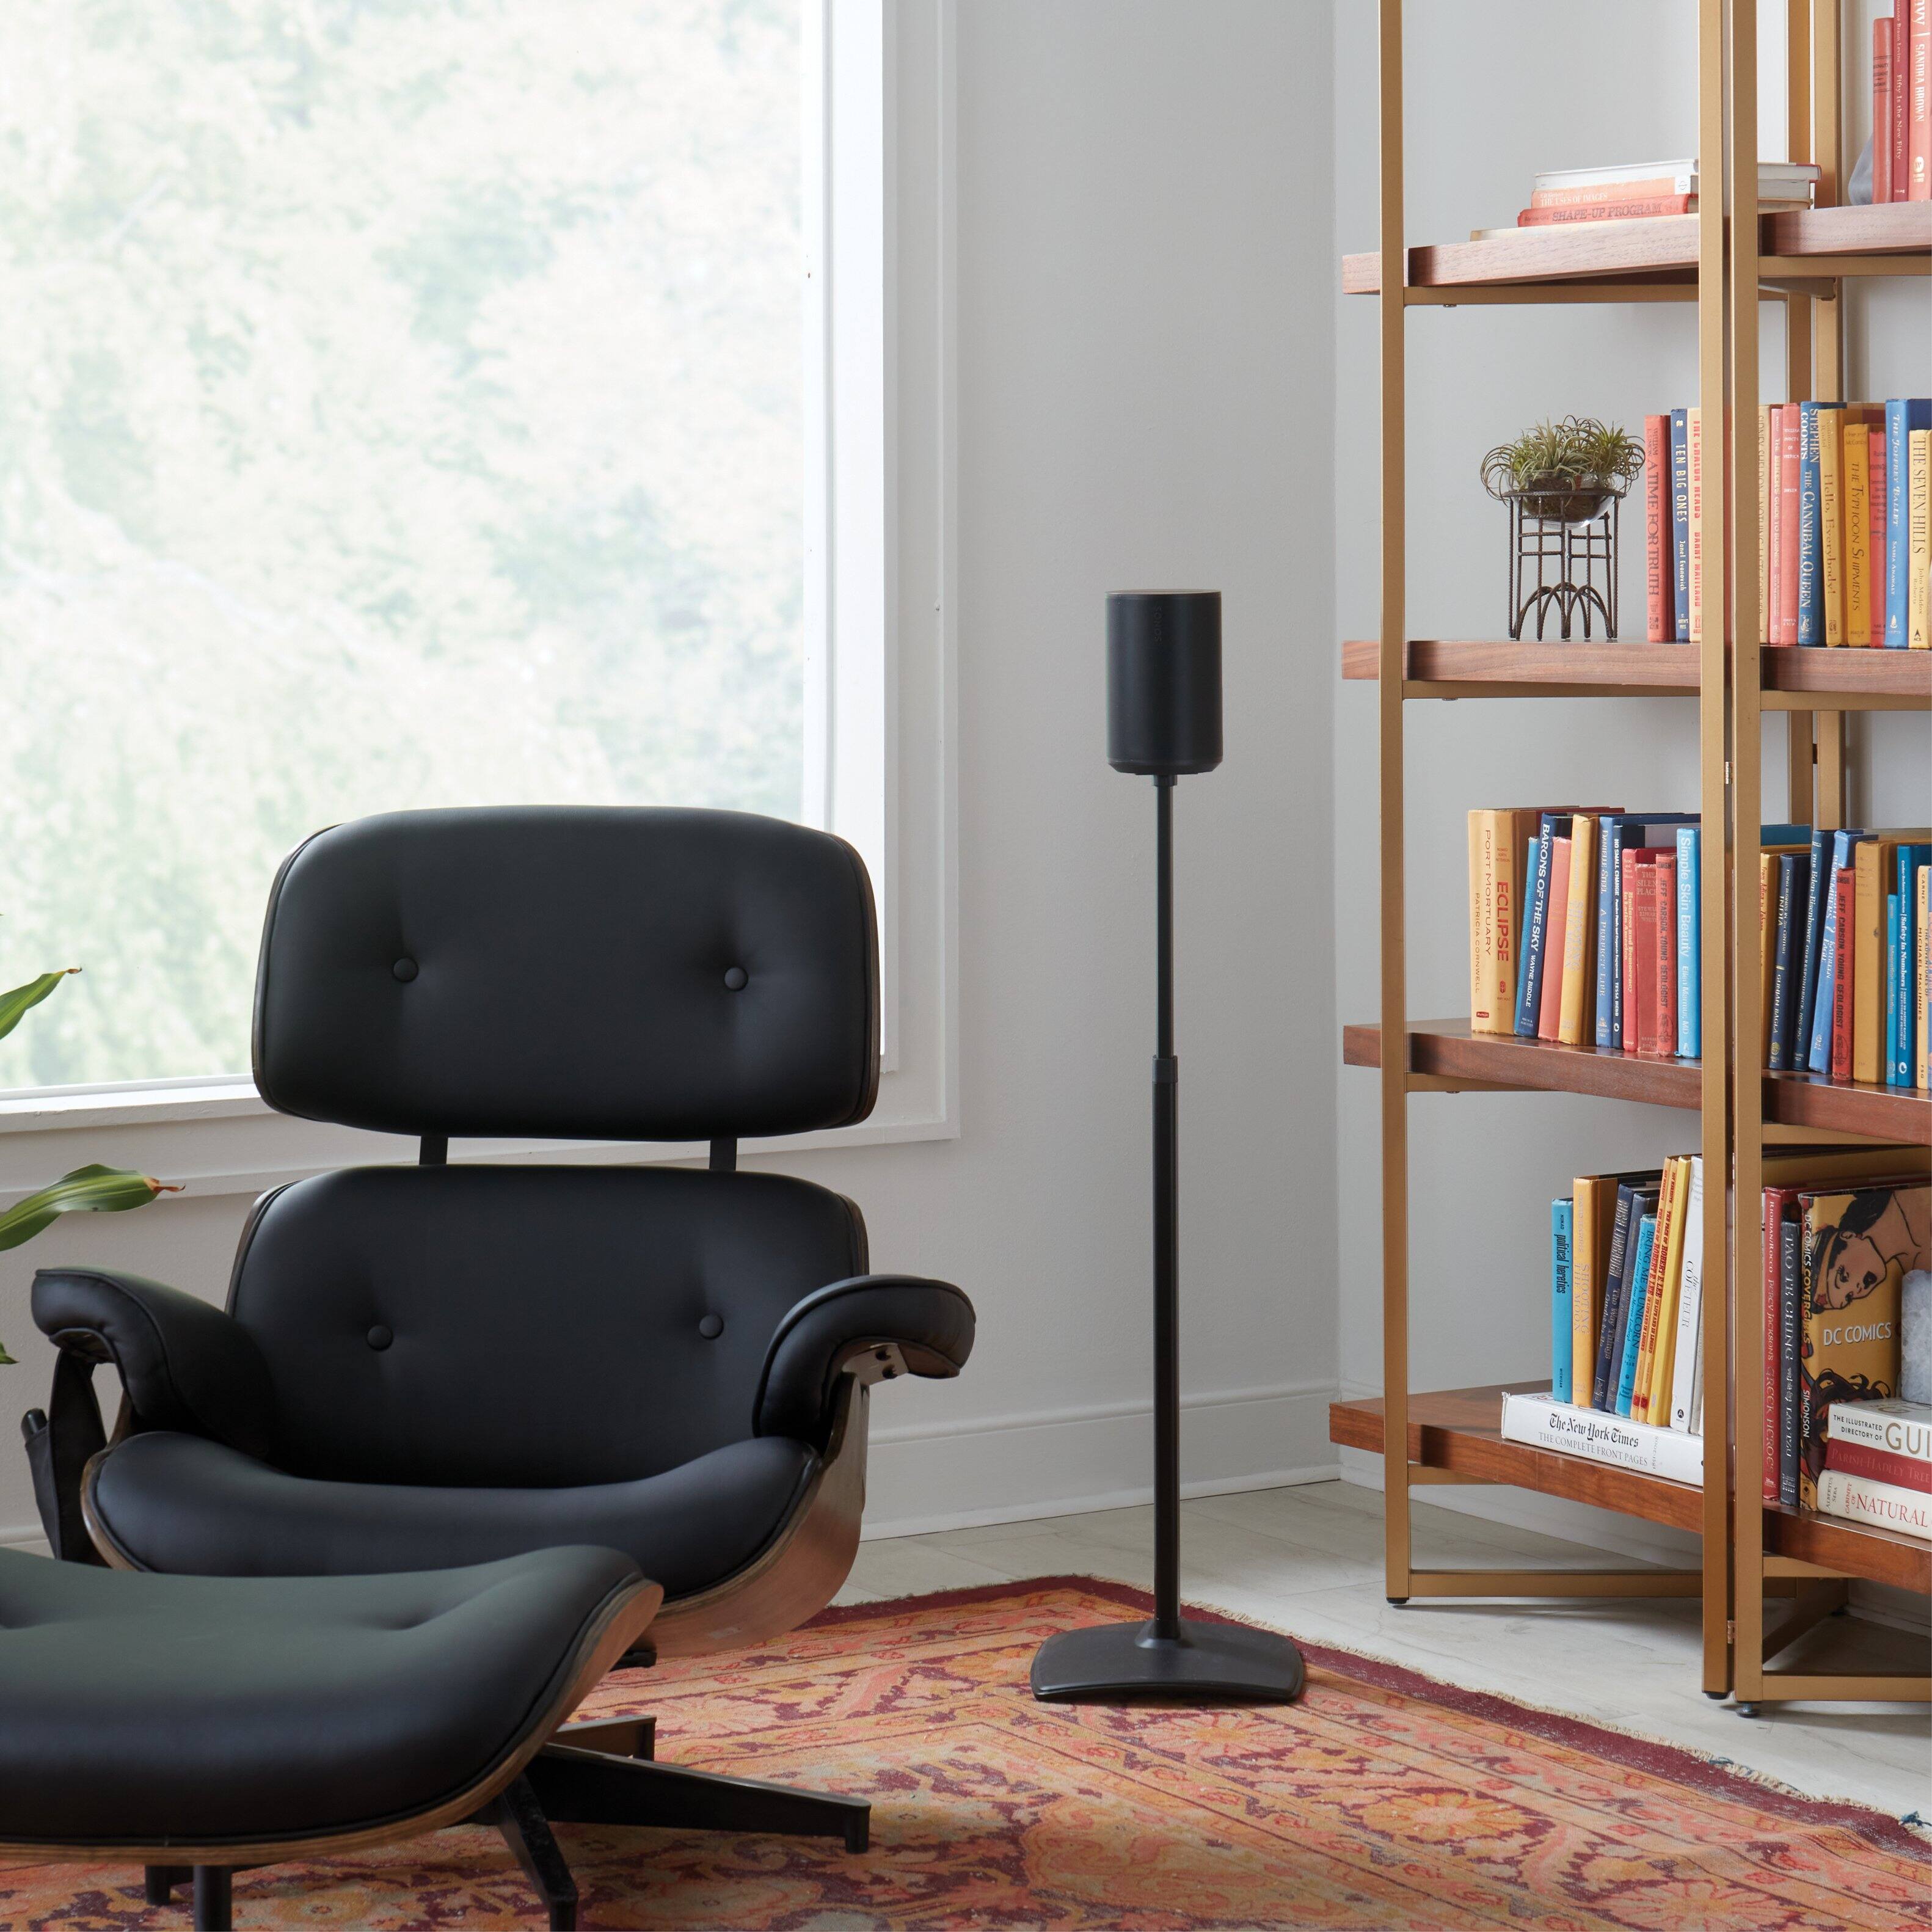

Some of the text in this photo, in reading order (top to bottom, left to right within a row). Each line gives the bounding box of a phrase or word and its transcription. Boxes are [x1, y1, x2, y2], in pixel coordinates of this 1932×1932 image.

[1915, 43, 1925, 122] SANDRA BROWN
[1540, 198, 1552, 206] THE
[1556, 197, 1572, 205] USES
[1583, 193, 1608, 202] IMAGES
[1552, 208, 1606, 222] SHAPE-UP
[1608, 203, 1662, 217] PROGRAM
[1809, 409, 1819, 462] STEPHEN
[1648, 459, 1658, 471] A
[1892, 439, 1900, 483] JOFFREY
[1648, 472, 1658, 510] TIME
[1675, 444, 1687, 522] TEN BIG ONES
[1912, 437, 1926, 553] THE SEVEN HILLS
[1648, 513, 1658, 545] FOR
[1774, 522, 1779, 531] TO
[1802, 491, 1815, 559] CANNIBAL
[1851, 485, 1864, 544] TYPHOON
[1824, 475, 1836, 594] Hello, Everybody!
[1649, 547, 1659, 596] TRUTH
[1801, 561, 1814, 607] QUEEN
[1852, 547, 1864, 611] SHIPMENTS
[1154, 605, 1162, 641] SONOS
[1614, 839, 1619, 848] NO
[1531, 824, 1550, 952] BARONS OF THE SKY
[1679, 837, 1691, 957] Simple Skin Beauty
[1497, 881, 1509, 961] ECLIPSE
[1806, 870, 1818, 944] Eden-Eisenhower
[1528, 955, 1536, 980] WAYNE
[1925, 988, 1928, 997] OF
[1683, 1021, 1689, 1035] MD
[1609, 1200, 1629, 1278] RUSH LIMBAUGH
[1804, 1214, 1812, 1229] DC
[1555, 1234, 1569, 1262] political
[1643, 1231, 1654, 1263] BRING
[1650, 1243, 1660, 1272] ROBERT
[1658, 1245, 1668, 1275] ROBERT
[1785, 1234, 1794, 1270] TAO
[1556, 1264, 1569, 1294] heretics
[1641, 1267, 1650, 1283] ME
[1785, 1274, 1794, 1296] TE
[1608, 1309, 1617, 1326] Way
[1631, 1297, 1645, 1349] UNICORN
[1803, 1269, 1812, 1344] COVERGIRLS
[1605, 1328, 1616, 1360] Things
[1785, 1301, 1794, 1360] CHING
[1823, 1322, 1892, 1346] DC COMICS
[1550, 1413, 1639, 1447] The New York Times
[1841, 1426, 1873, 1440] DIRECTORY
[1846, 1418, 1883, 1431] ILLUSTRATED
[1539, 1431, 1648, 1466] THE COMPLETE FRONT PAGES
[1832, 1448, 1930, 1483] PARISH-HADLEY TREE
[1851, 1495, 1856, 1504] OF
[1856, 1493, 1928, 1528] NATURAL
